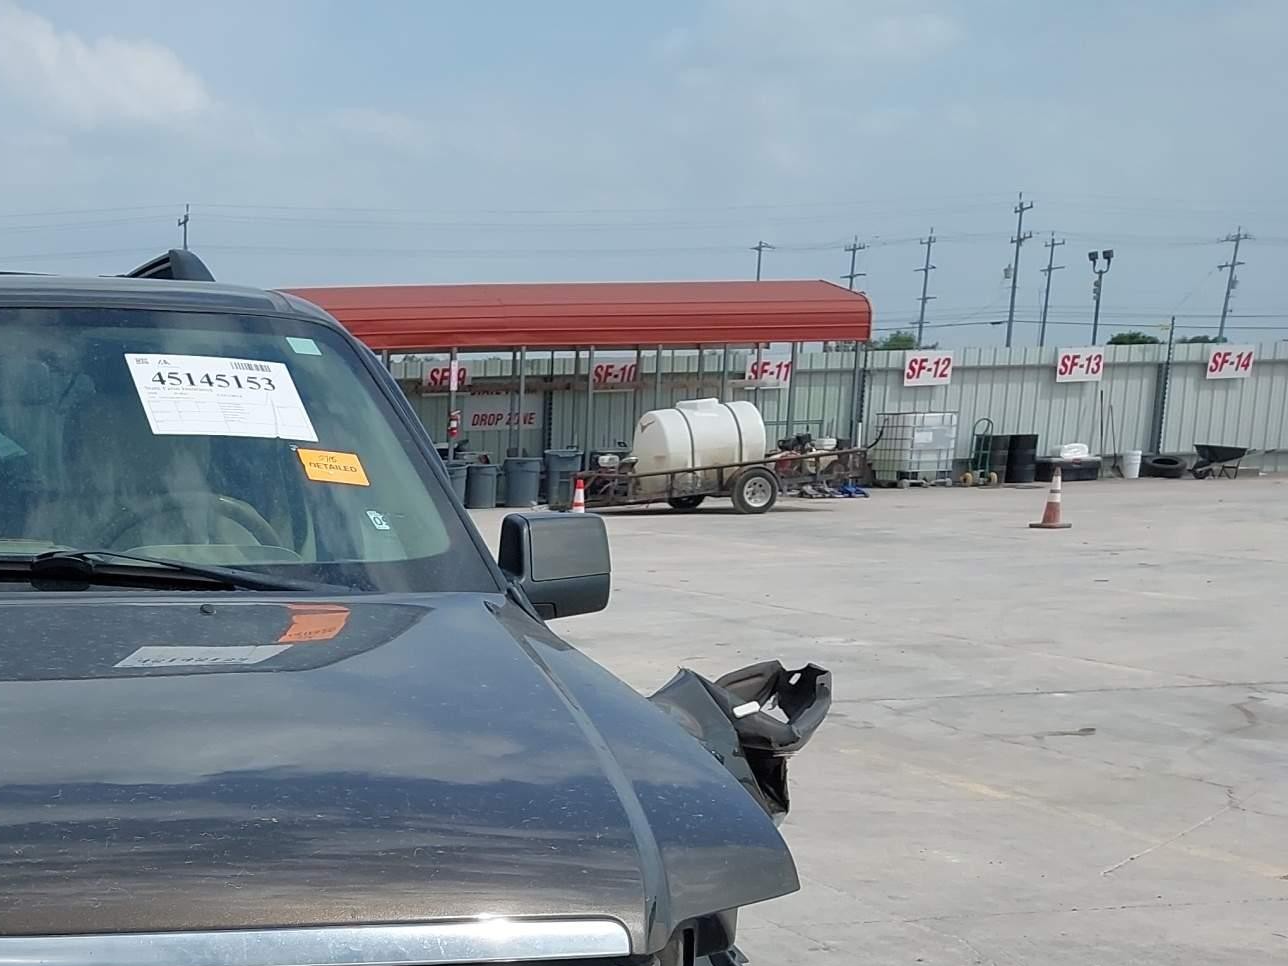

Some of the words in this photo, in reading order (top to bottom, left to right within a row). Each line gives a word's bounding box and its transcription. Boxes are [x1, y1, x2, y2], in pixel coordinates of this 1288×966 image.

[748, 360, 792, 382] SF-11
[906, 357, 952, 380] SF-12
[1058, 353, 1103, 376] SF-13
[1209, 351, 1253, 373] SF-14
[152, 371, 276, 391] 45145153
[428, 367, 467, 387] SF9
[471, 413, 504, 427] DROP
